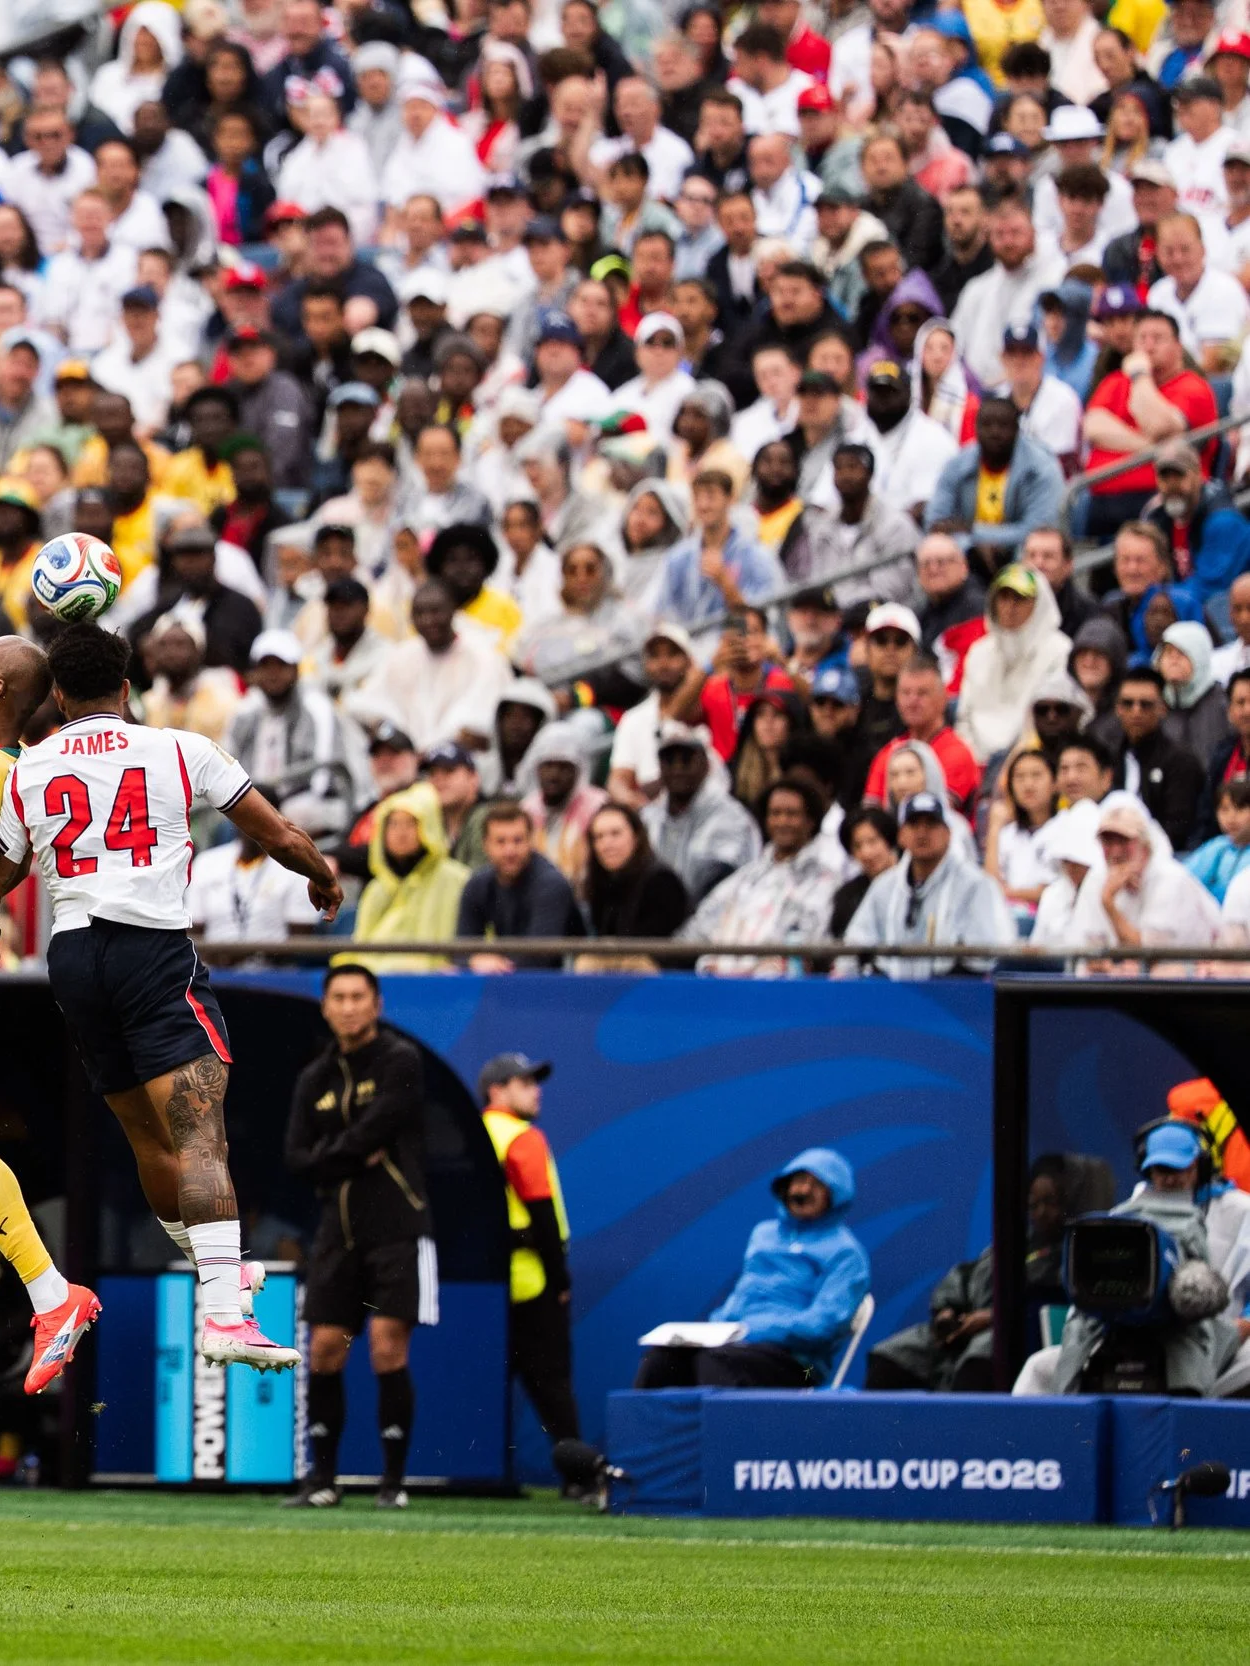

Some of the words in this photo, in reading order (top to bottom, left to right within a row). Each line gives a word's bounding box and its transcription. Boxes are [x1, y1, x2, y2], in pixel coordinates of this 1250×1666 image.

[59, 730, 129, 756] JAMES
[43, 767, 158, 878] 24
[734, 1459, 795, 1491] FIFA
[796, 1459, 900, 1490] WORLD
[901, 1459, 959, 1490] CUP
[961, 1459, 1062, 1490] 2026
